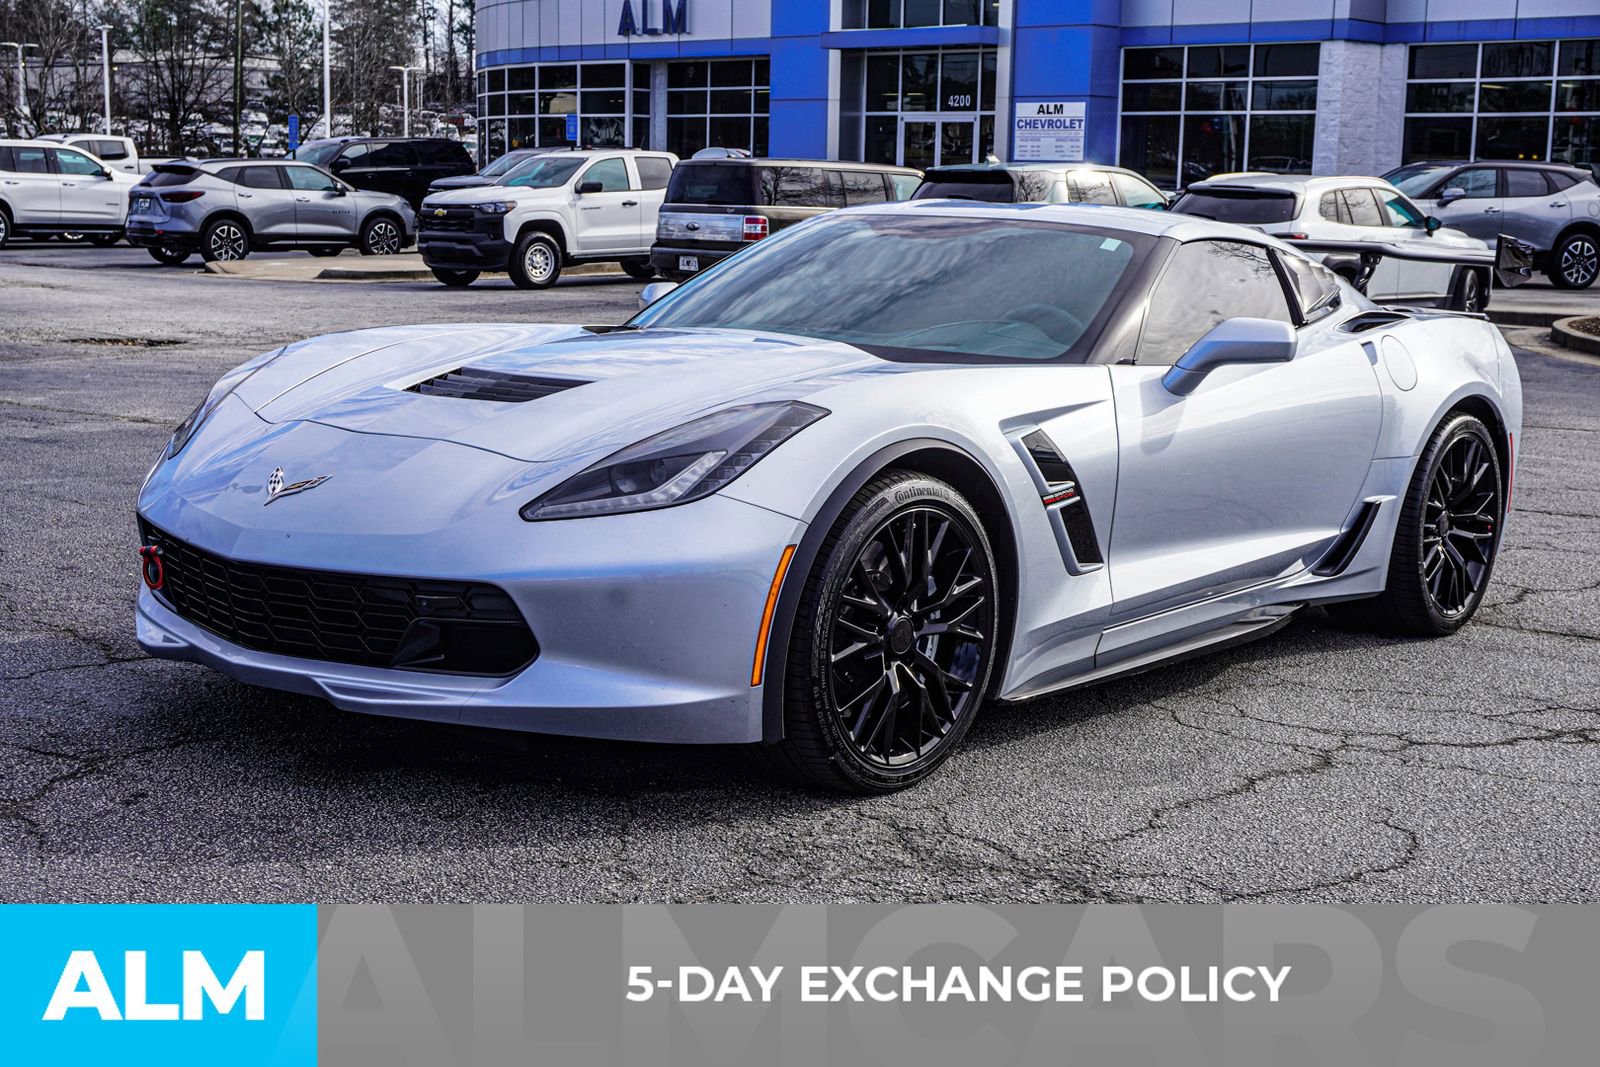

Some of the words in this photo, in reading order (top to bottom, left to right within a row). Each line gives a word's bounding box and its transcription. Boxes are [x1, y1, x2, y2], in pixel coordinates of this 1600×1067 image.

[617, 0, 692, 36] ALM
[948, 95, 971, 107] 4200
[1037, 104, 1064, 115] ALM
[1016, 119, 1084, 129] CHEVROLET
[895, 486, 943, 504] Continental
